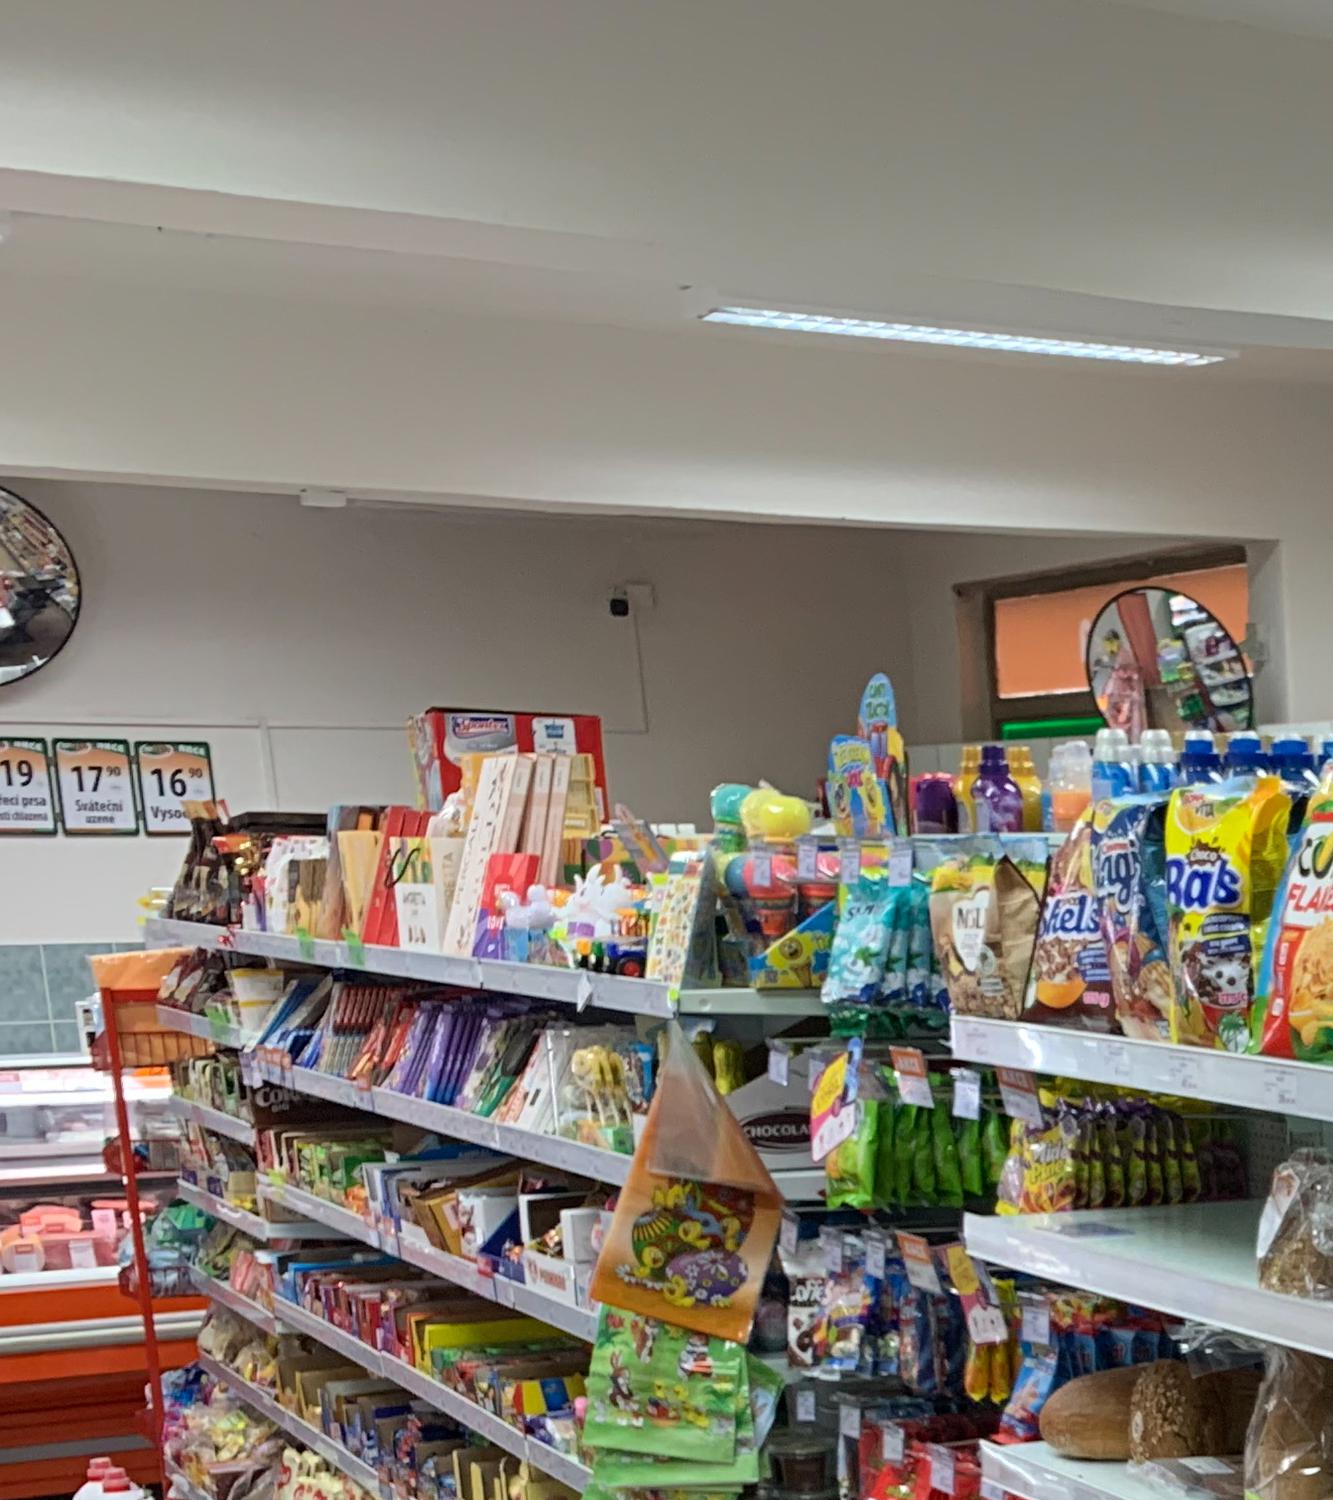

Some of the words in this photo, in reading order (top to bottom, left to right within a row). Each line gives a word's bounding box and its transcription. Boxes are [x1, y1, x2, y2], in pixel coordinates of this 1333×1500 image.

[71, 766, 103, 792] 17
[150, 768, 188, 797] 16
[743, 1123, 811, 1140] CHOCOLA
